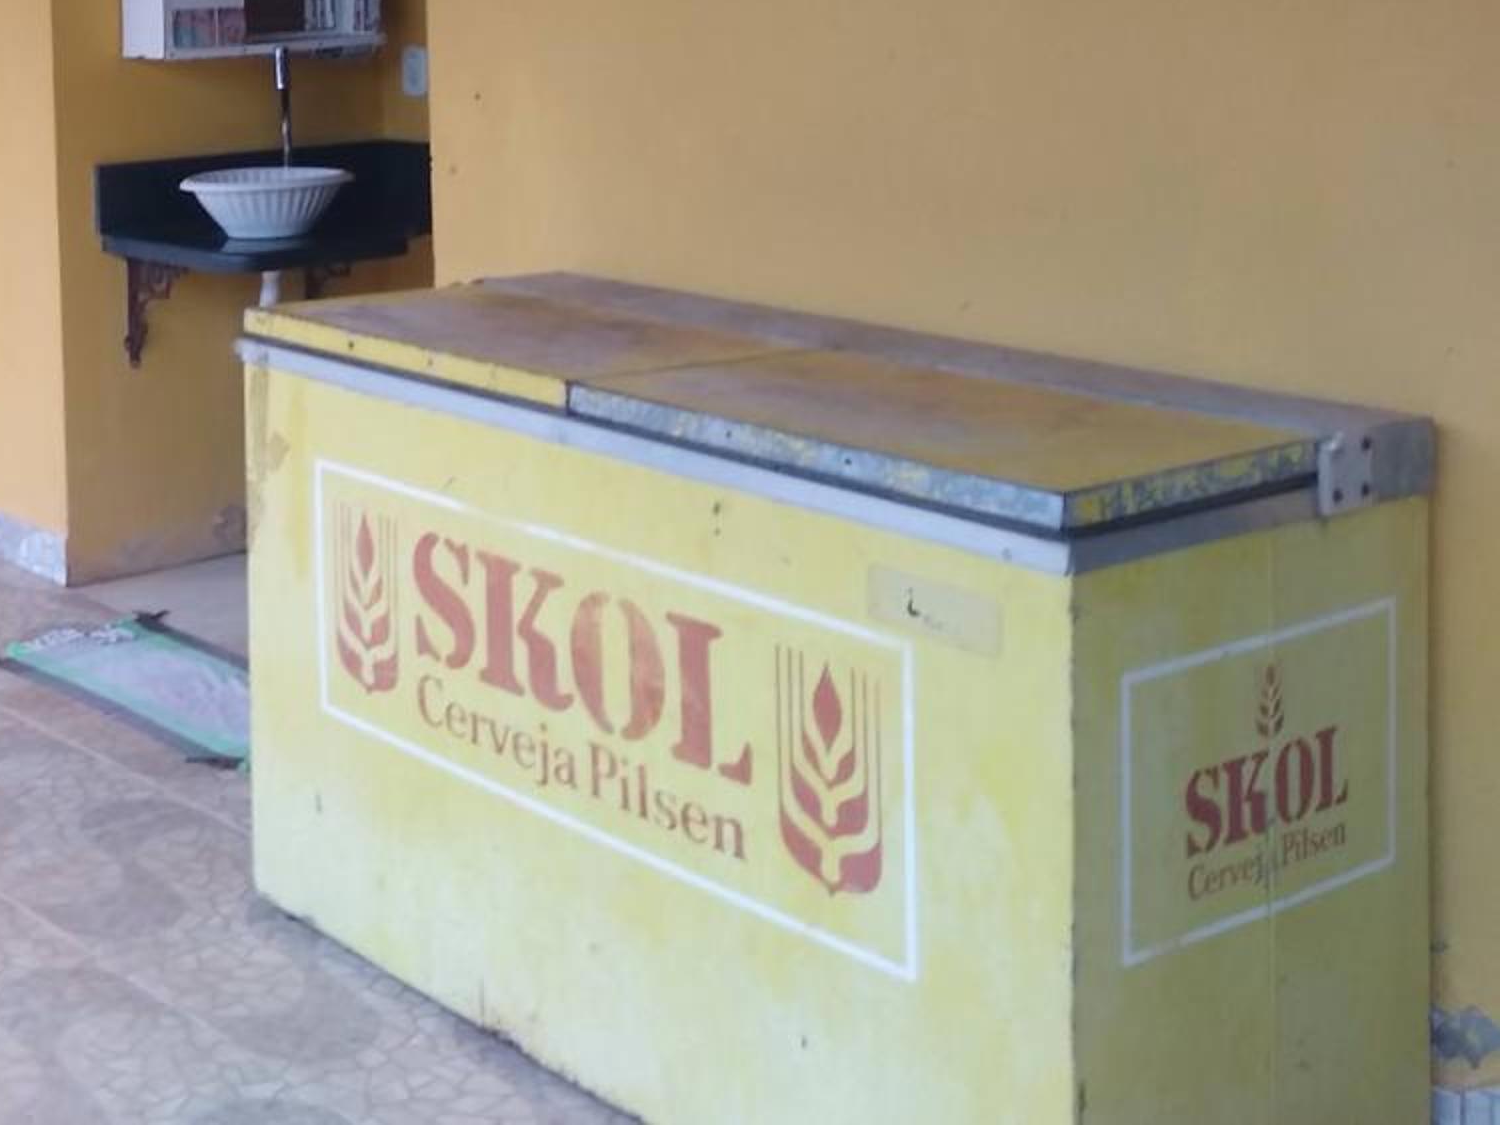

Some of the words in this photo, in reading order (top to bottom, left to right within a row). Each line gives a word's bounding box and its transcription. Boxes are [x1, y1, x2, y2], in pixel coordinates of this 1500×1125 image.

[413, 532, 752, 785] SKOL
[417, 676, 576, 789] Cerveja
[589, 742, 746, 861] Pilsen
[1185, 726, 1348, 859] SKOL
[1282, 822, 1346, 866] Pilsen
